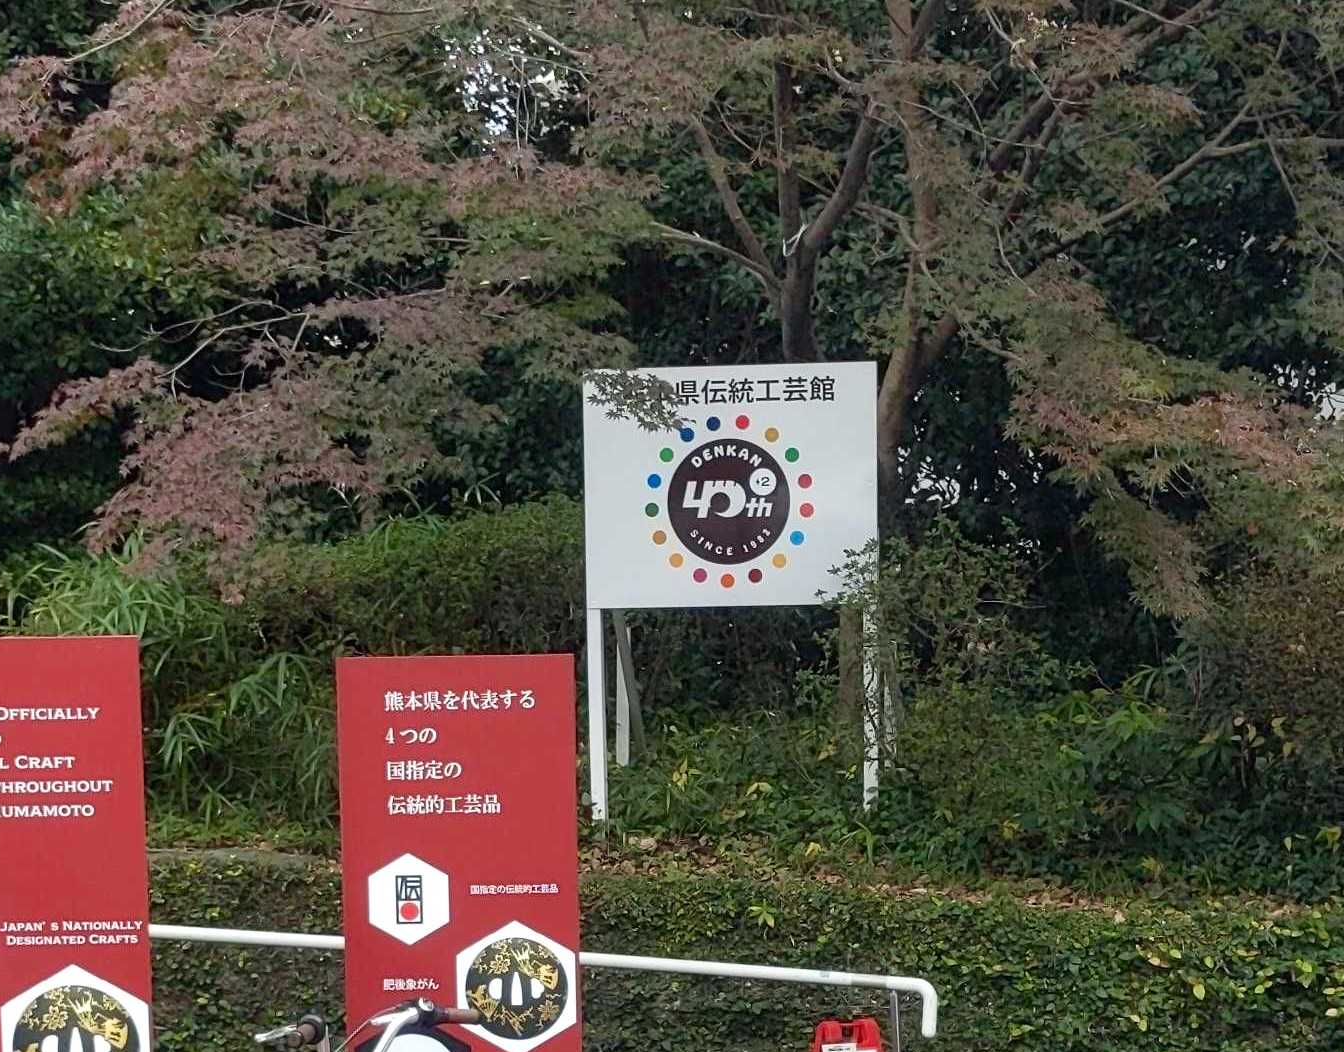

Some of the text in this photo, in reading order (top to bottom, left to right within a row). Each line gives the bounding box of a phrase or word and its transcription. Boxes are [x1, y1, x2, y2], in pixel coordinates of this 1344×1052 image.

[622, 376, 836, 405] 県伝統工芸館
[691, 445, 762, 468] DENKAN
[689, 529, 734, 556] SINCE
[384, 690, 536, 711] 熊本県を代表する
[386, 761, 462, 780] 国指定の
[387, 794, 501, 815] 伝統的工芸品
[383, 978, 439, 991] 肥後象がん
